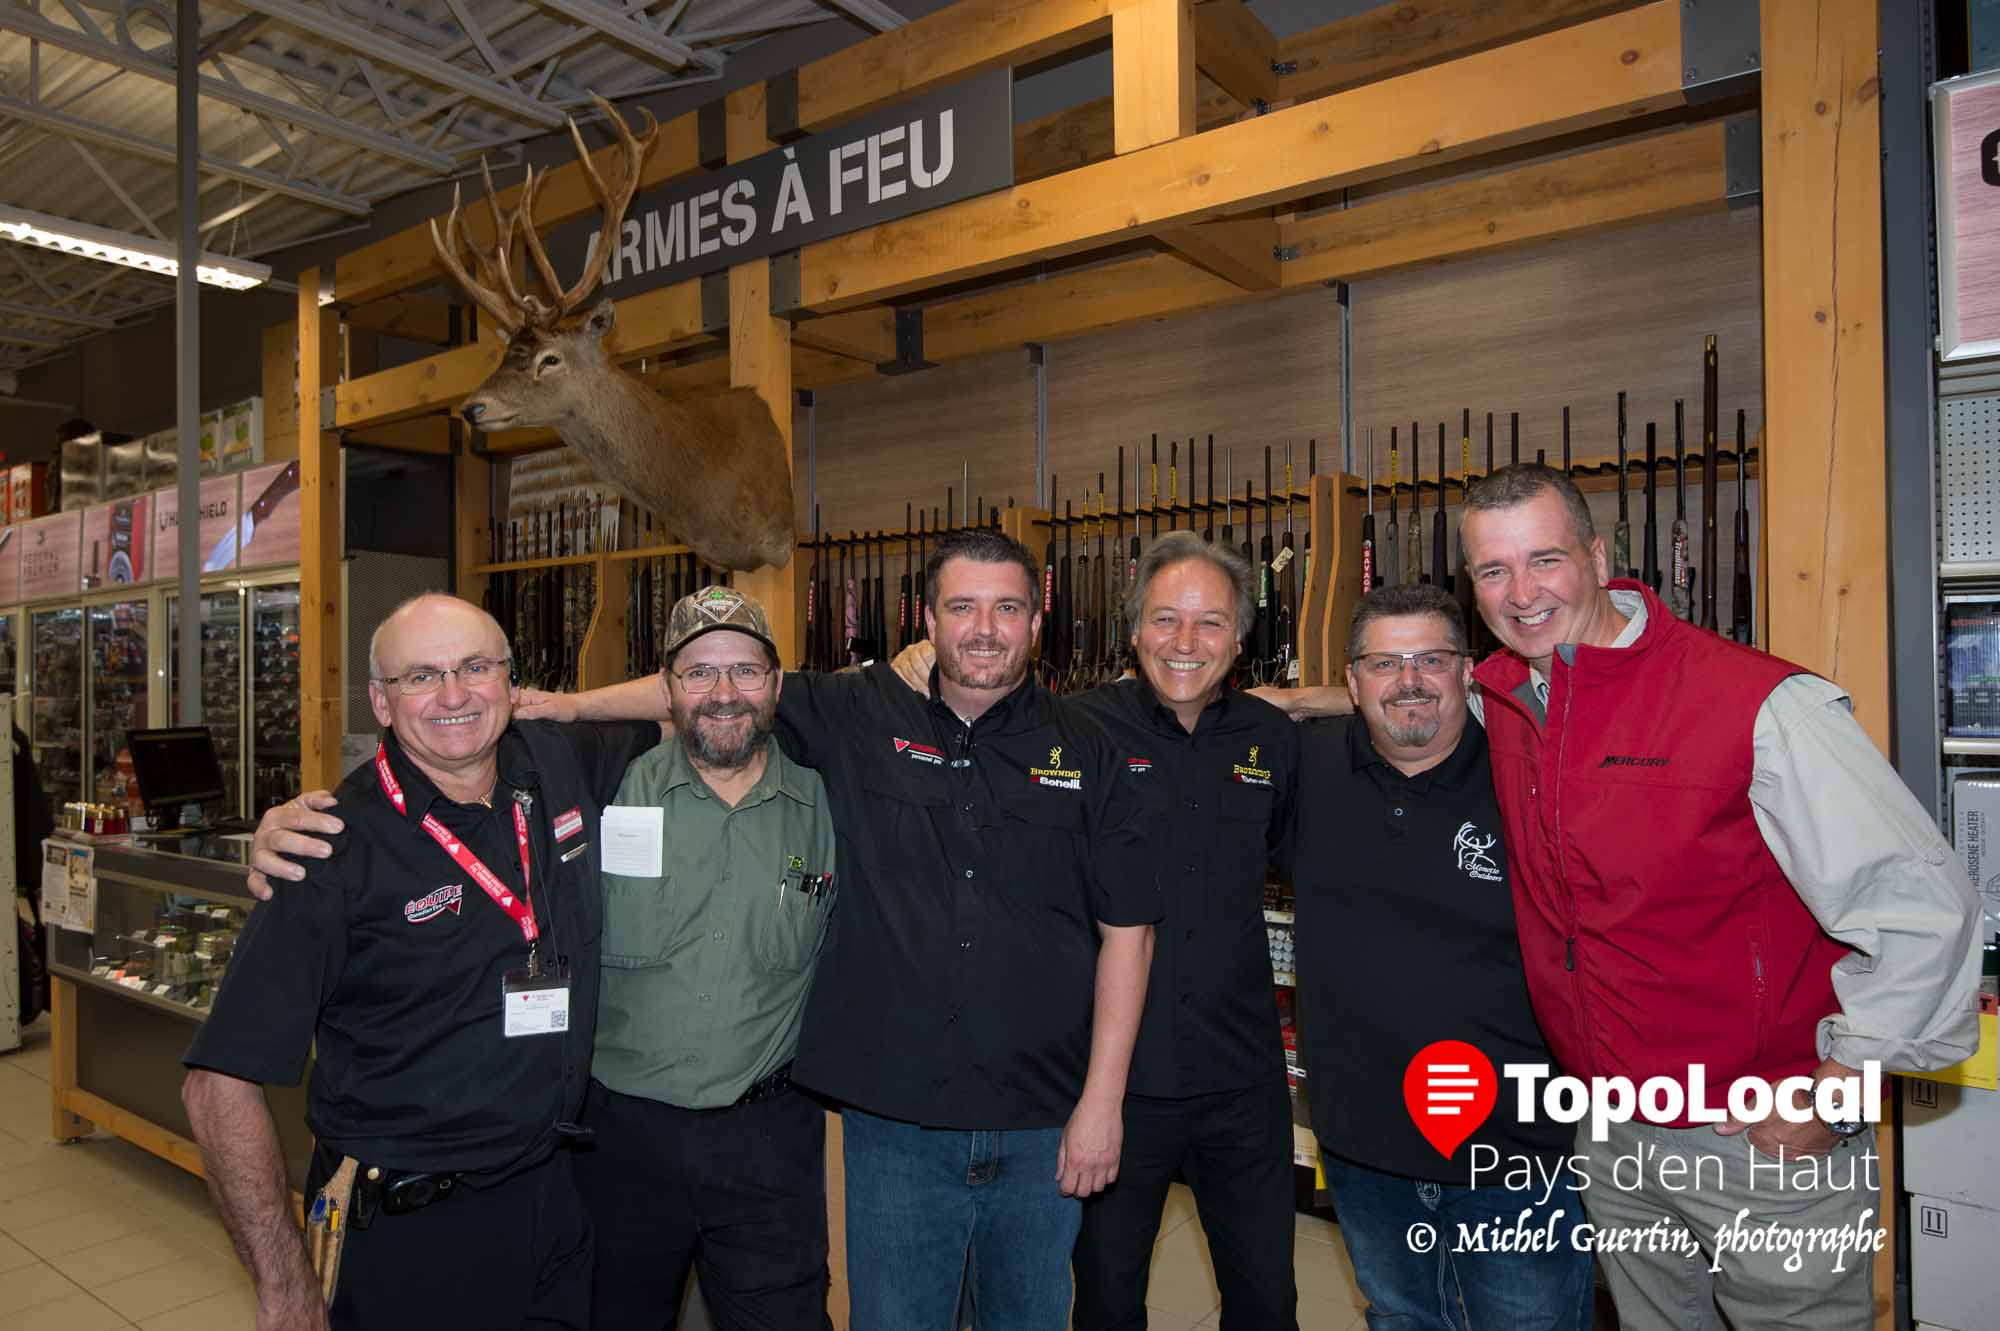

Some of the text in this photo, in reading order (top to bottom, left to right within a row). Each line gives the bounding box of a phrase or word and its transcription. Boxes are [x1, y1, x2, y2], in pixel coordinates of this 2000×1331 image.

[584, 109, 955, 285] ARMES À FEU
[1030, 768, 1082, 779] BROWNING
[1967, 810, 1980, 842] HEATER
[404, 884, 463, 916] ÉQUIPE
